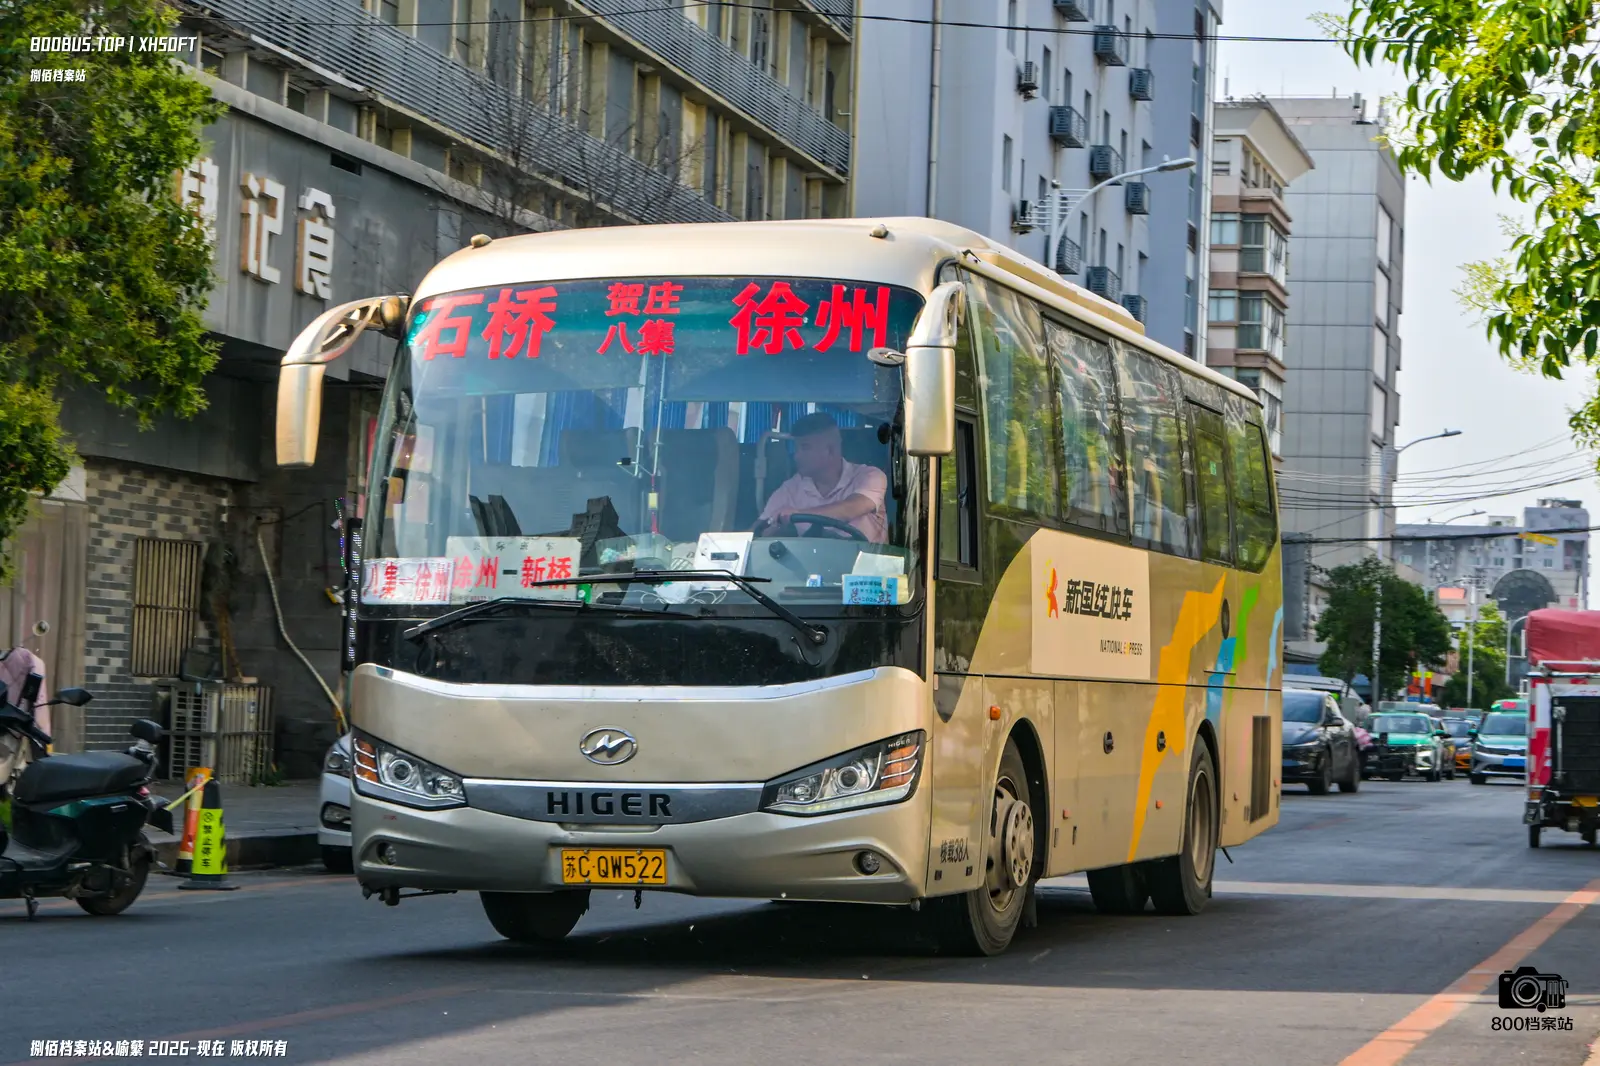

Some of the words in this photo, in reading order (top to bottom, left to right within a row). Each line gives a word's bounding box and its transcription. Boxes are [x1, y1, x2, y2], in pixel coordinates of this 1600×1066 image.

[605, 283, 684, 317] 贺庄
[729, 281, 891, 356] 徐州
[414, 284, 558, 361] 石桥
[597, 318, 676, 356] 八集
[1062, 579, 1134, 622] 新国线快车
[888, 738, 911, 748] HIGER
[547, 791, 673, 817] HIGER
[201, 824, 213, 868] 禁止停车
